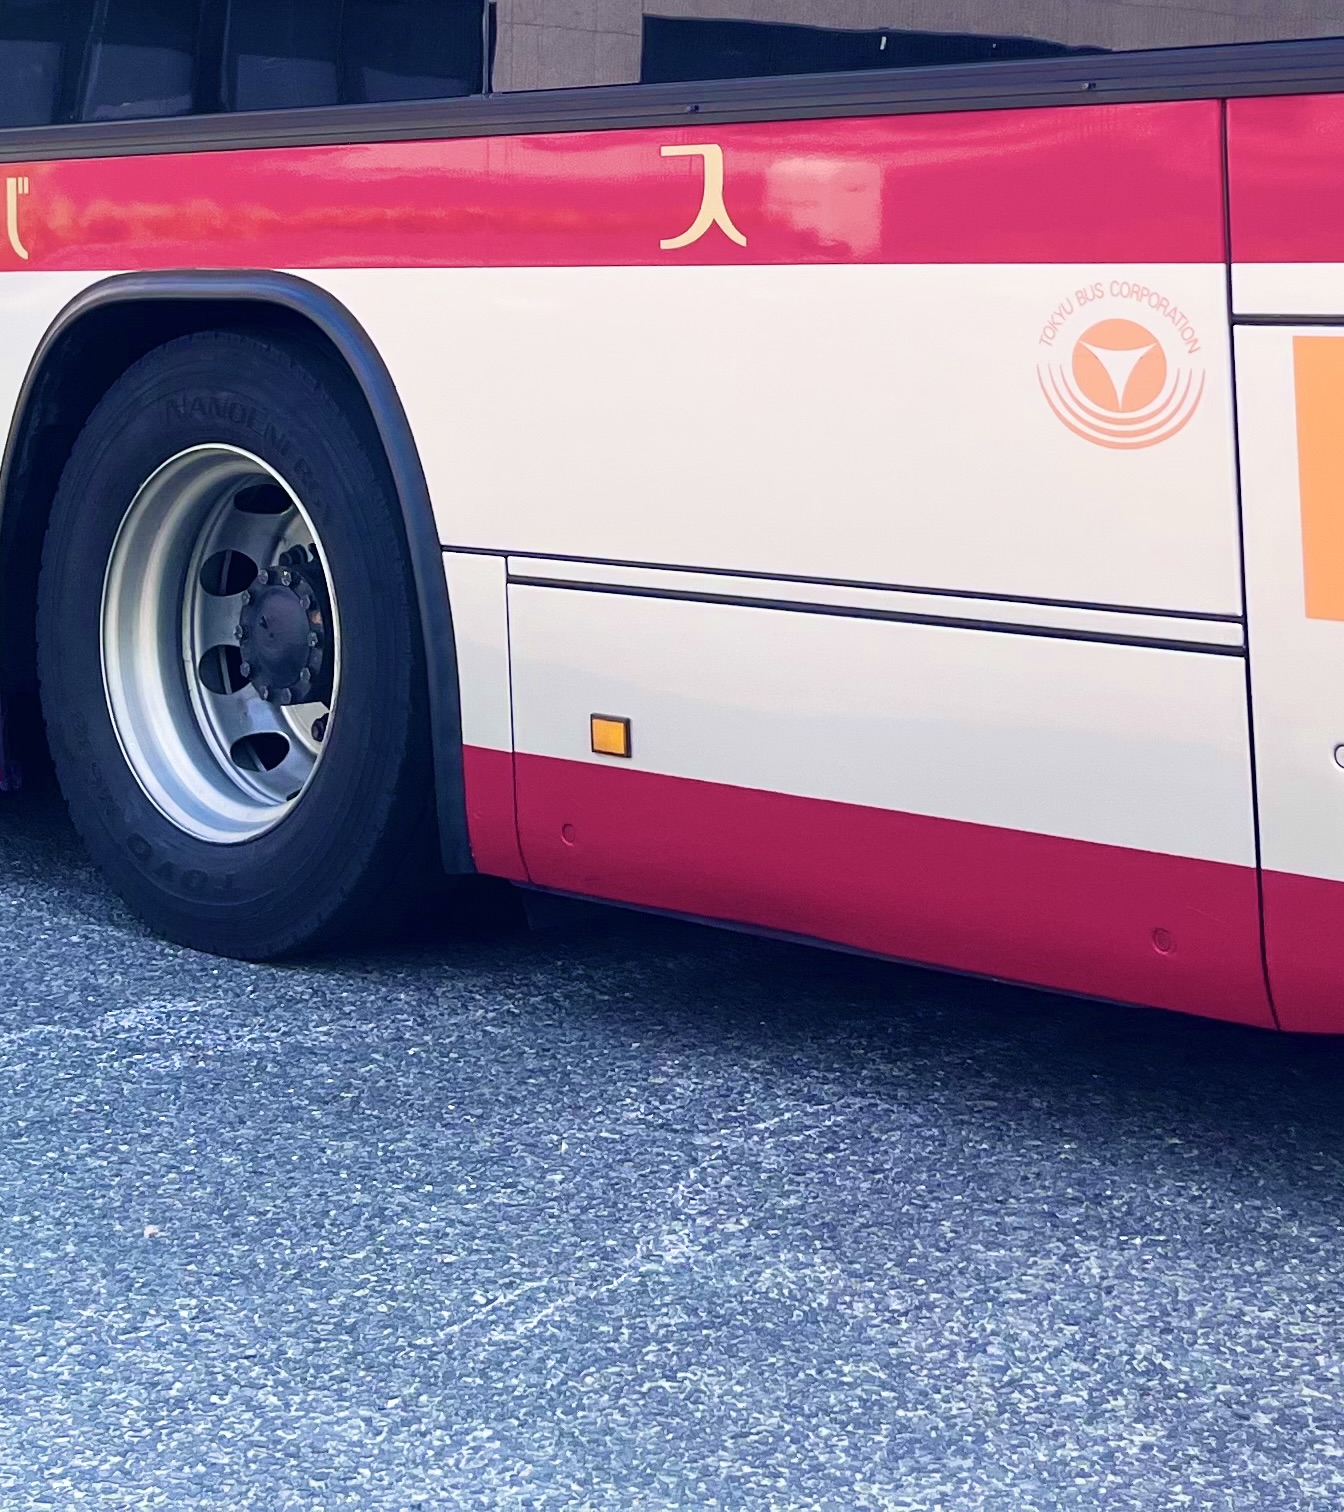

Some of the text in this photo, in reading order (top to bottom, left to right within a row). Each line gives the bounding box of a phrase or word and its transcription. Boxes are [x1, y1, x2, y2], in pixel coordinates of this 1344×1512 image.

[1038, 279, 1201, 354] TOKYU BUS CORPORATION
